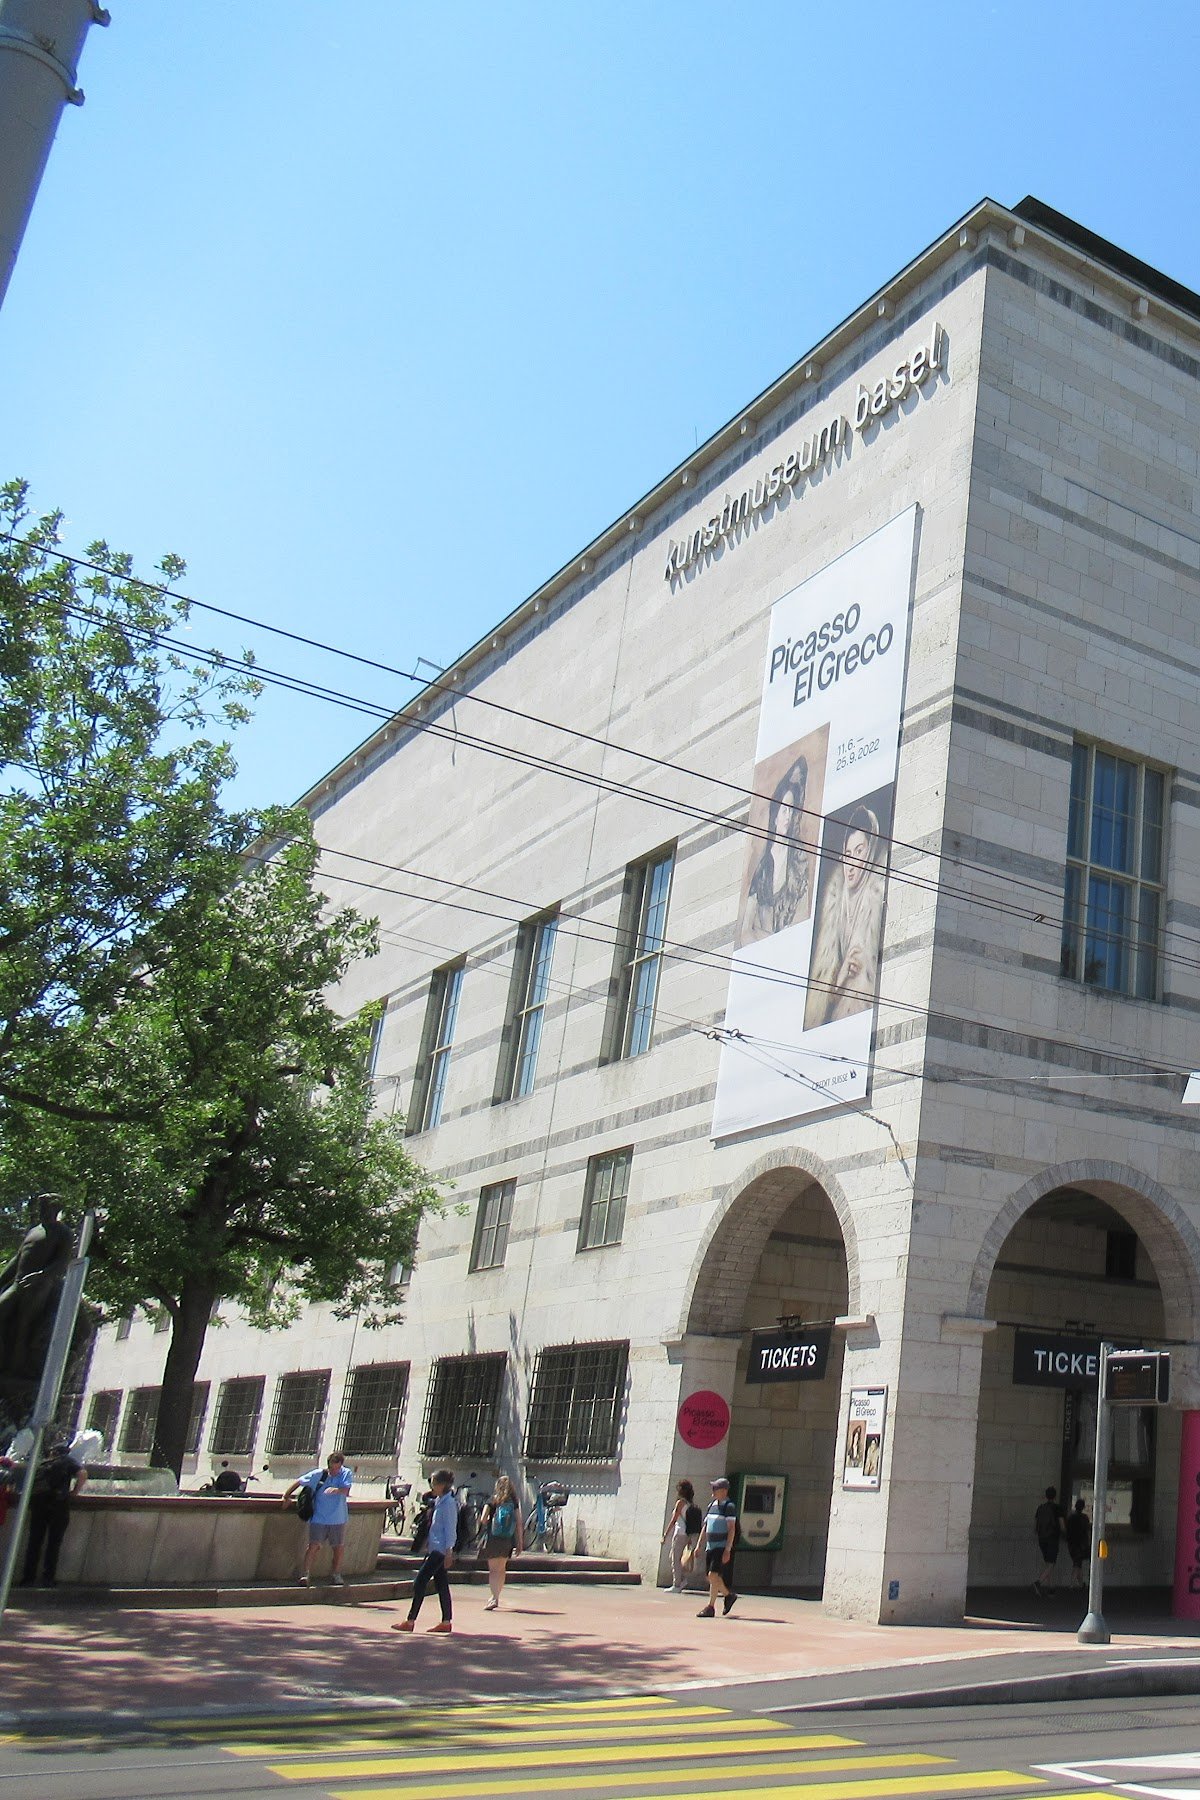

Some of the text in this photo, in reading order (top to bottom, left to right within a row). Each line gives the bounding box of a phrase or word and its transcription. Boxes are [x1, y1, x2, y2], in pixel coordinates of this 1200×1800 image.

[664, 322, 944, 582] kunstmuseum basel
[769, 603, 861, 684] Picasso
[793, 623, 894, 708] El Greco
[836, 738, 880, 771] 25.9.2022
[760, 1344, 817, 1370] TICKETS
[1033, 1350, 1101, 1376] TICKE
[850, 1398, 871, 1407] Picasso
